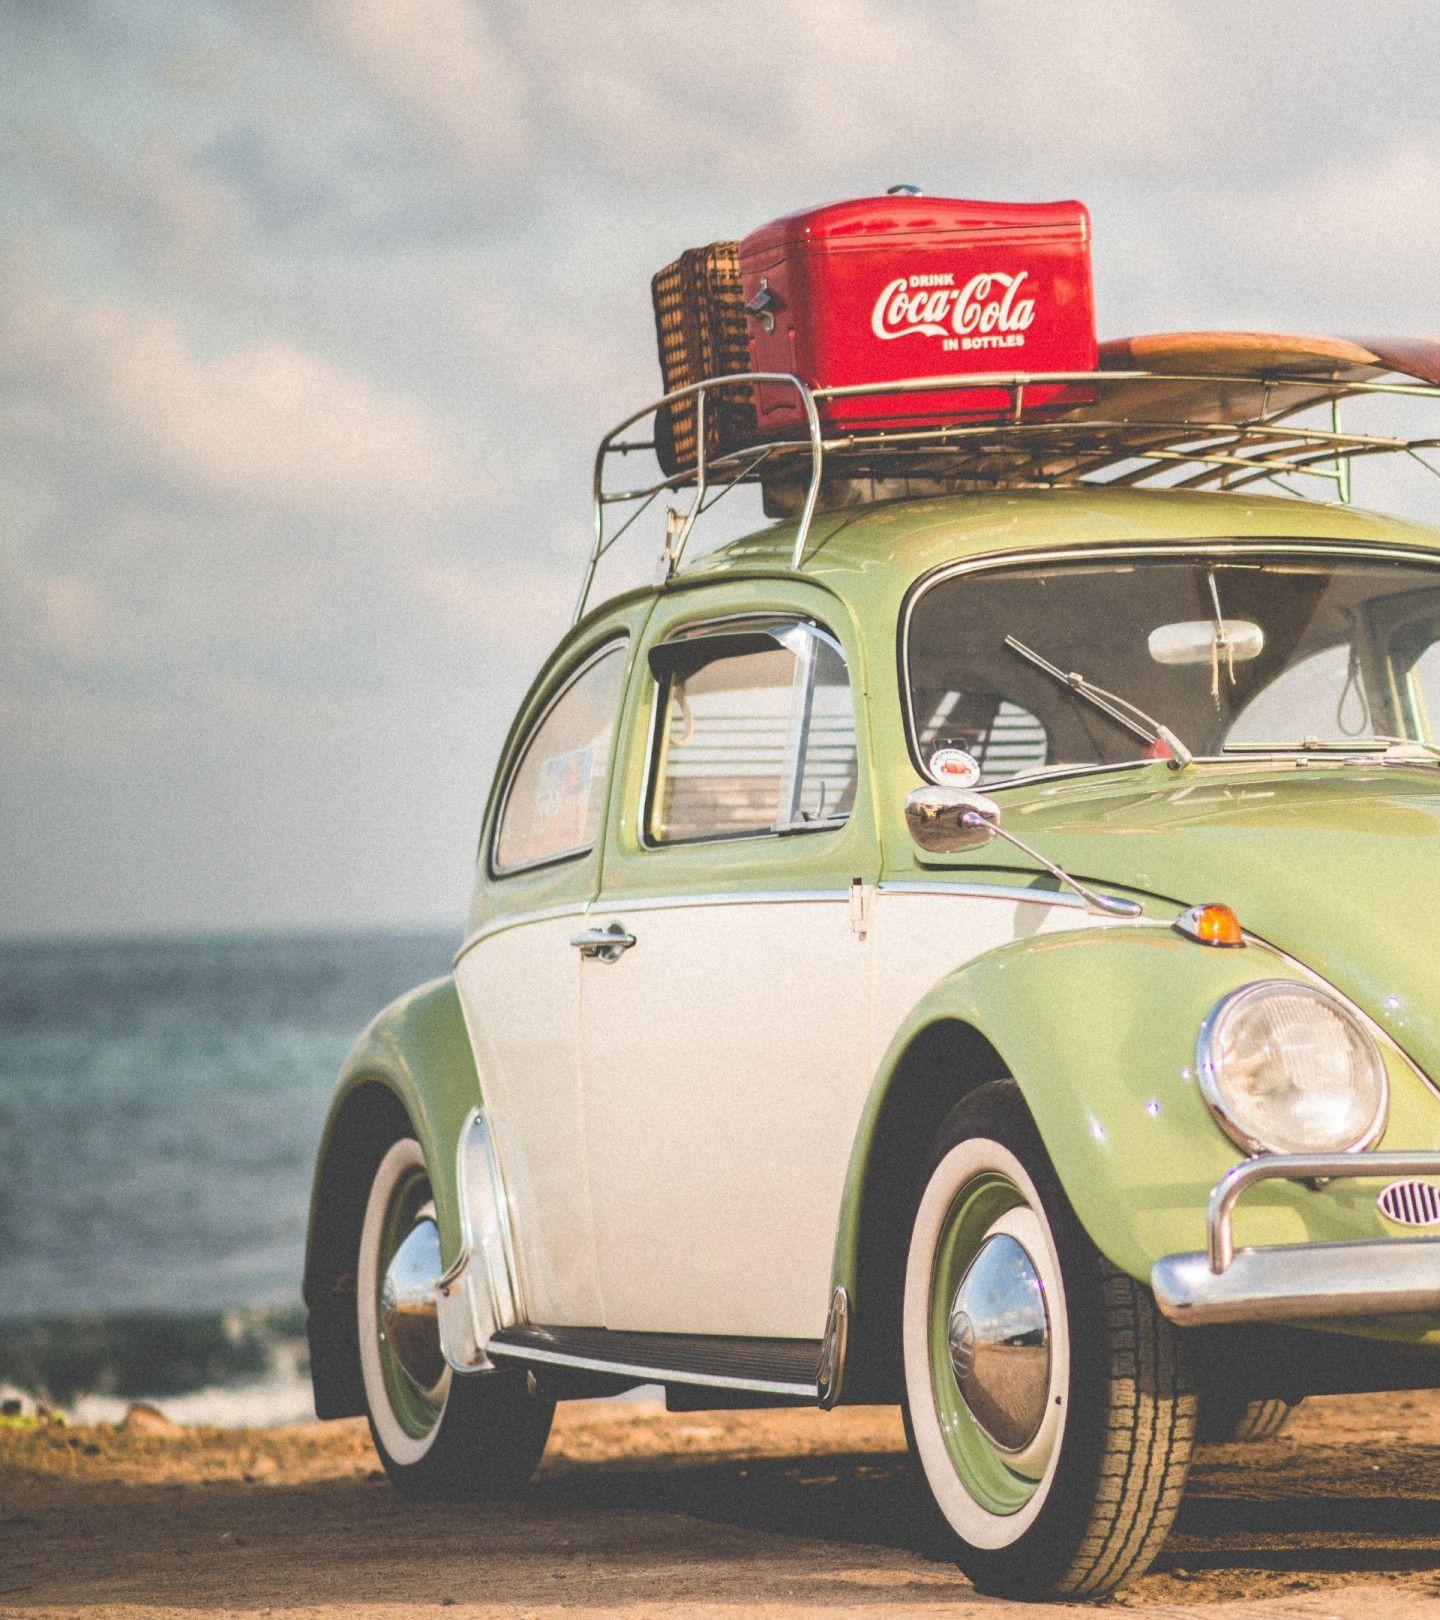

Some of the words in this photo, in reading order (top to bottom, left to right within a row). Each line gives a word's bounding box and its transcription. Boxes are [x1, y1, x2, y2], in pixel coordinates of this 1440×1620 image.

[909, 274, 954, 288] DRINK
[871, 271, 1036, 340] Coca-Cola
[943, 338, 959, 351] IN
[961, 334, 1025, 350] BOTTLES
